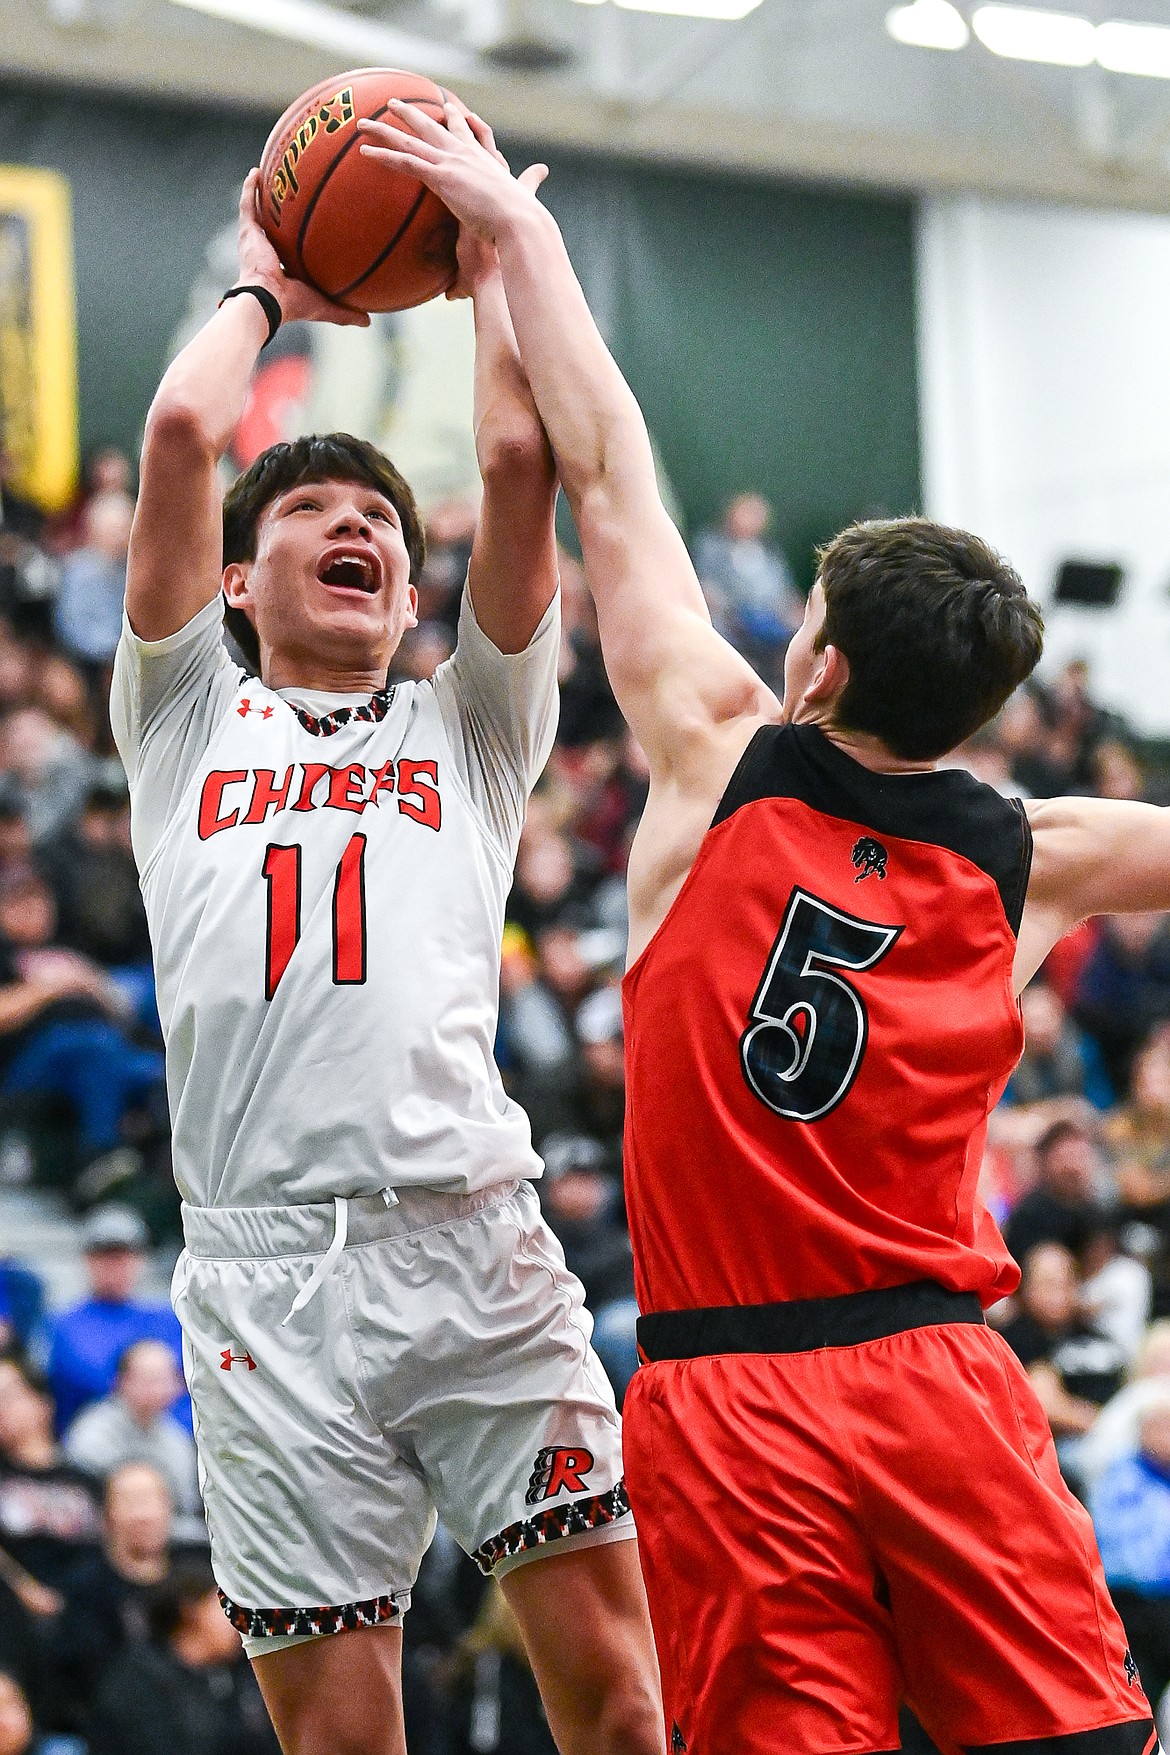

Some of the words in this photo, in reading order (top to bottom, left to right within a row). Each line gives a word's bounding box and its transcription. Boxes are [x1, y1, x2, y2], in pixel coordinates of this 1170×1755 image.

[268, 85, 355, 229] Baden
[198, 758, 442, 841] CHIEFS
[261, 832, 367, 1002] 11
[739, 884, 906, 1123] 5
[543, 1447, 595, 1500] R
